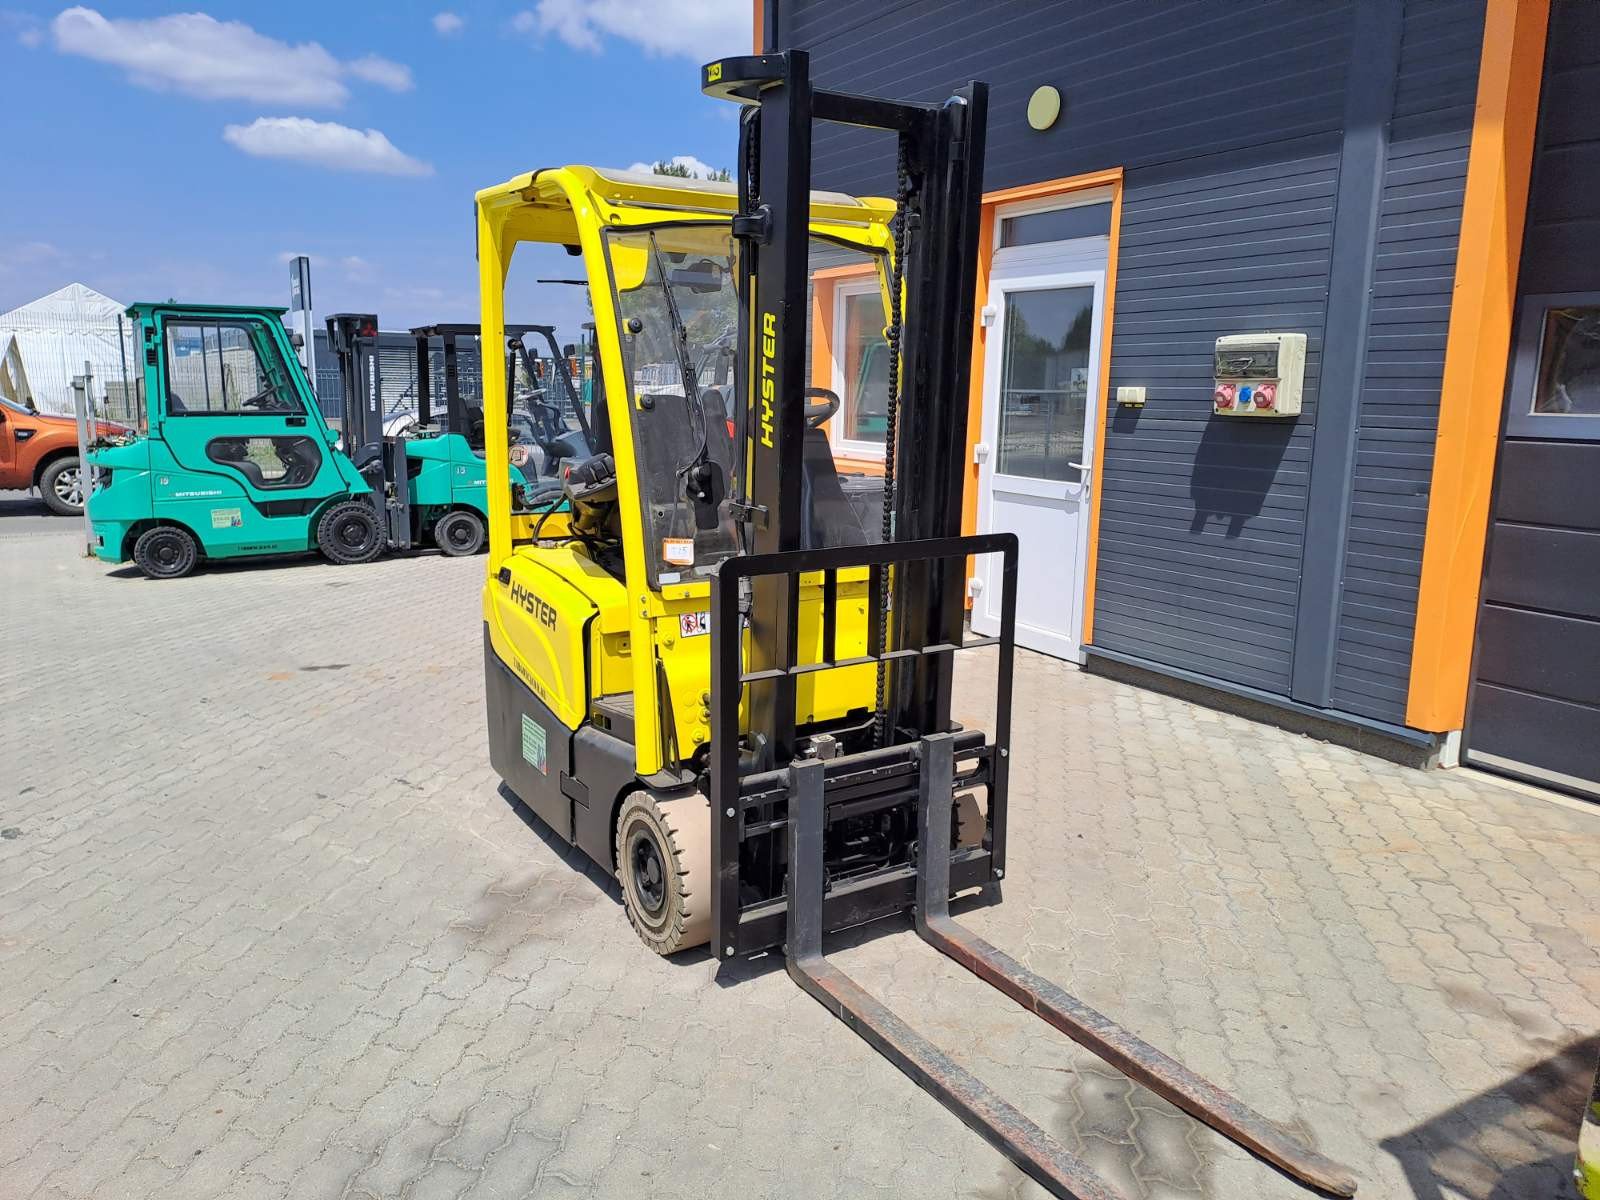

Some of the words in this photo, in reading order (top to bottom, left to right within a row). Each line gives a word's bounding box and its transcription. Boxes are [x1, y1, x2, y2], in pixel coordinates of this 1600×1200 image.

[368, 354, 376, 412] MITSUBISHI
[760, 312, 776, 449] HYSTER
[510, 580, 557, 632] HYSTER
